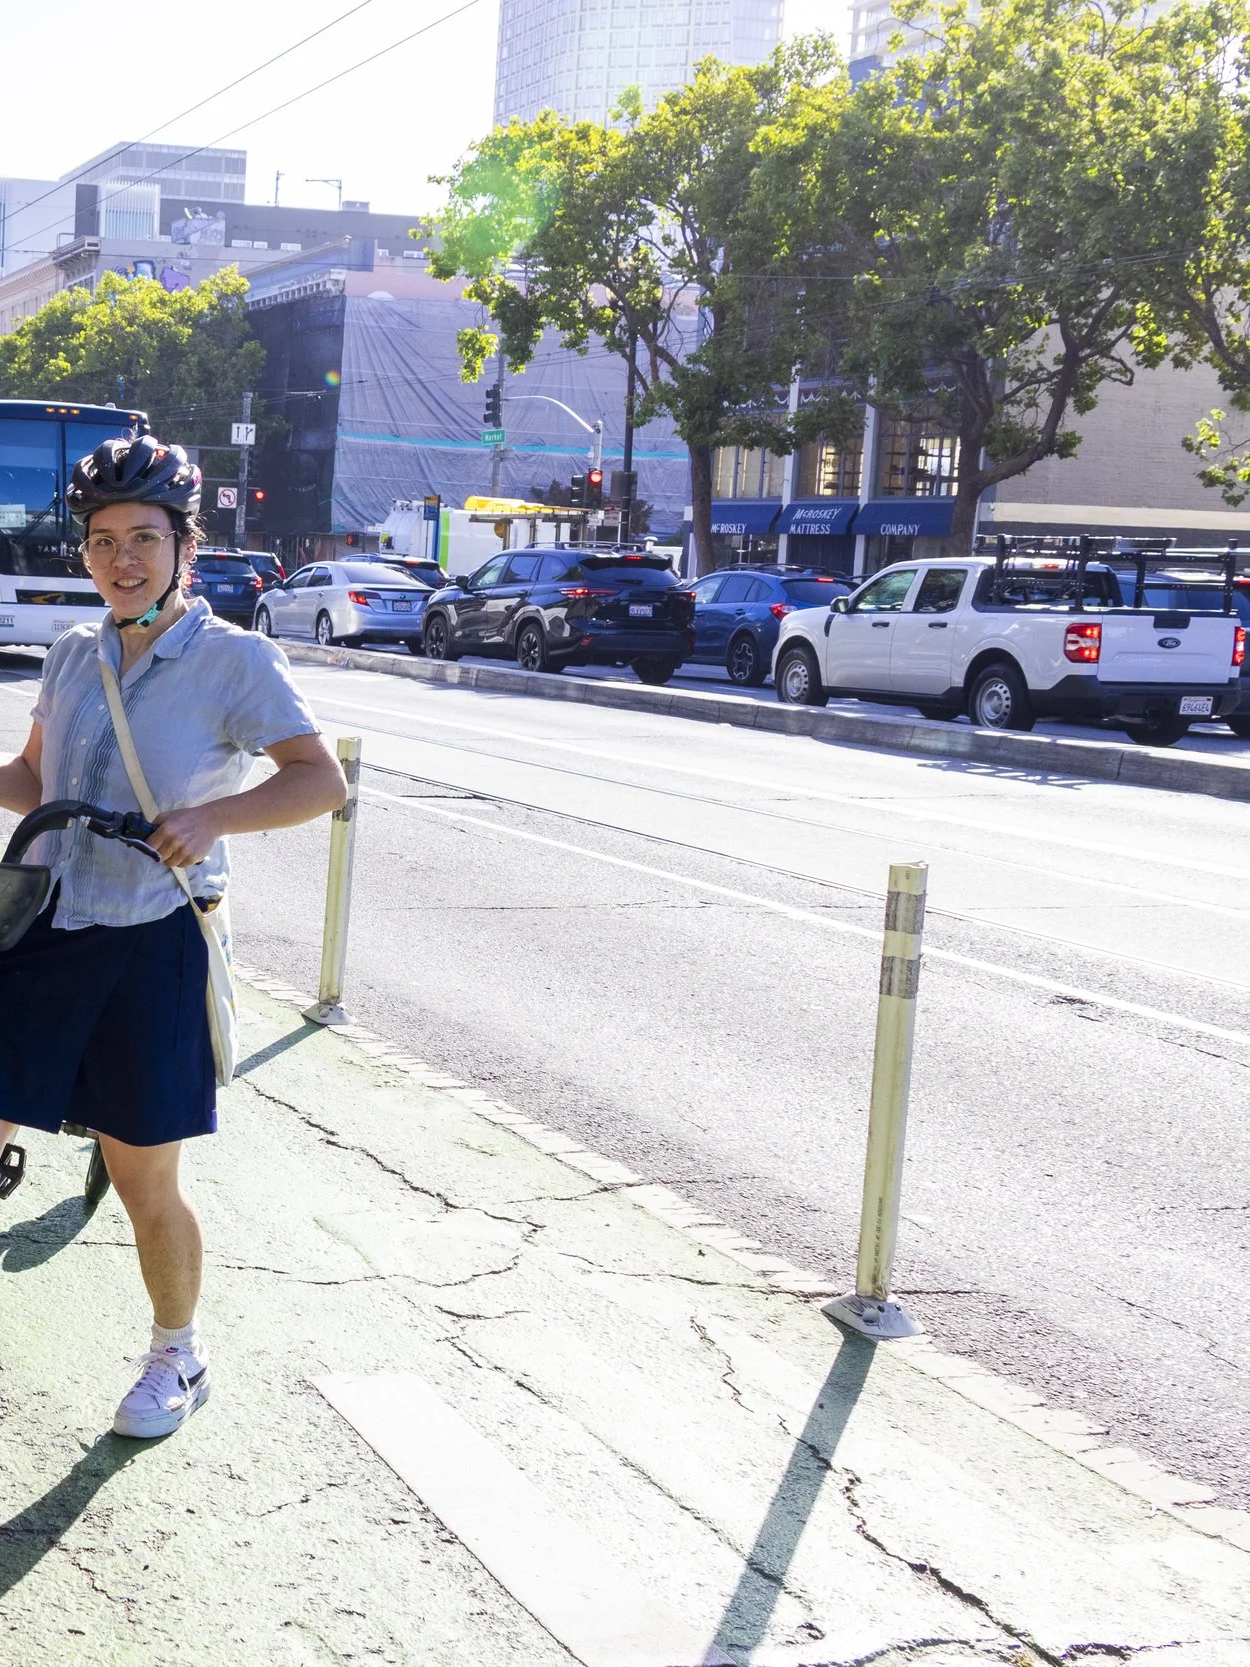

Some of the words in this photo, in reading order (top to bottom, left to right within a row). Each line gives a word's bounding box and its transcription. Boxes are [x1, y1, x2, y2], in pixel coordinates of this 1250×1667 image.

[484, 432, 502, 441] Market
[789, 523, 830, 534] MATTRESS
[880, 523, 920, 535] COMPANY
